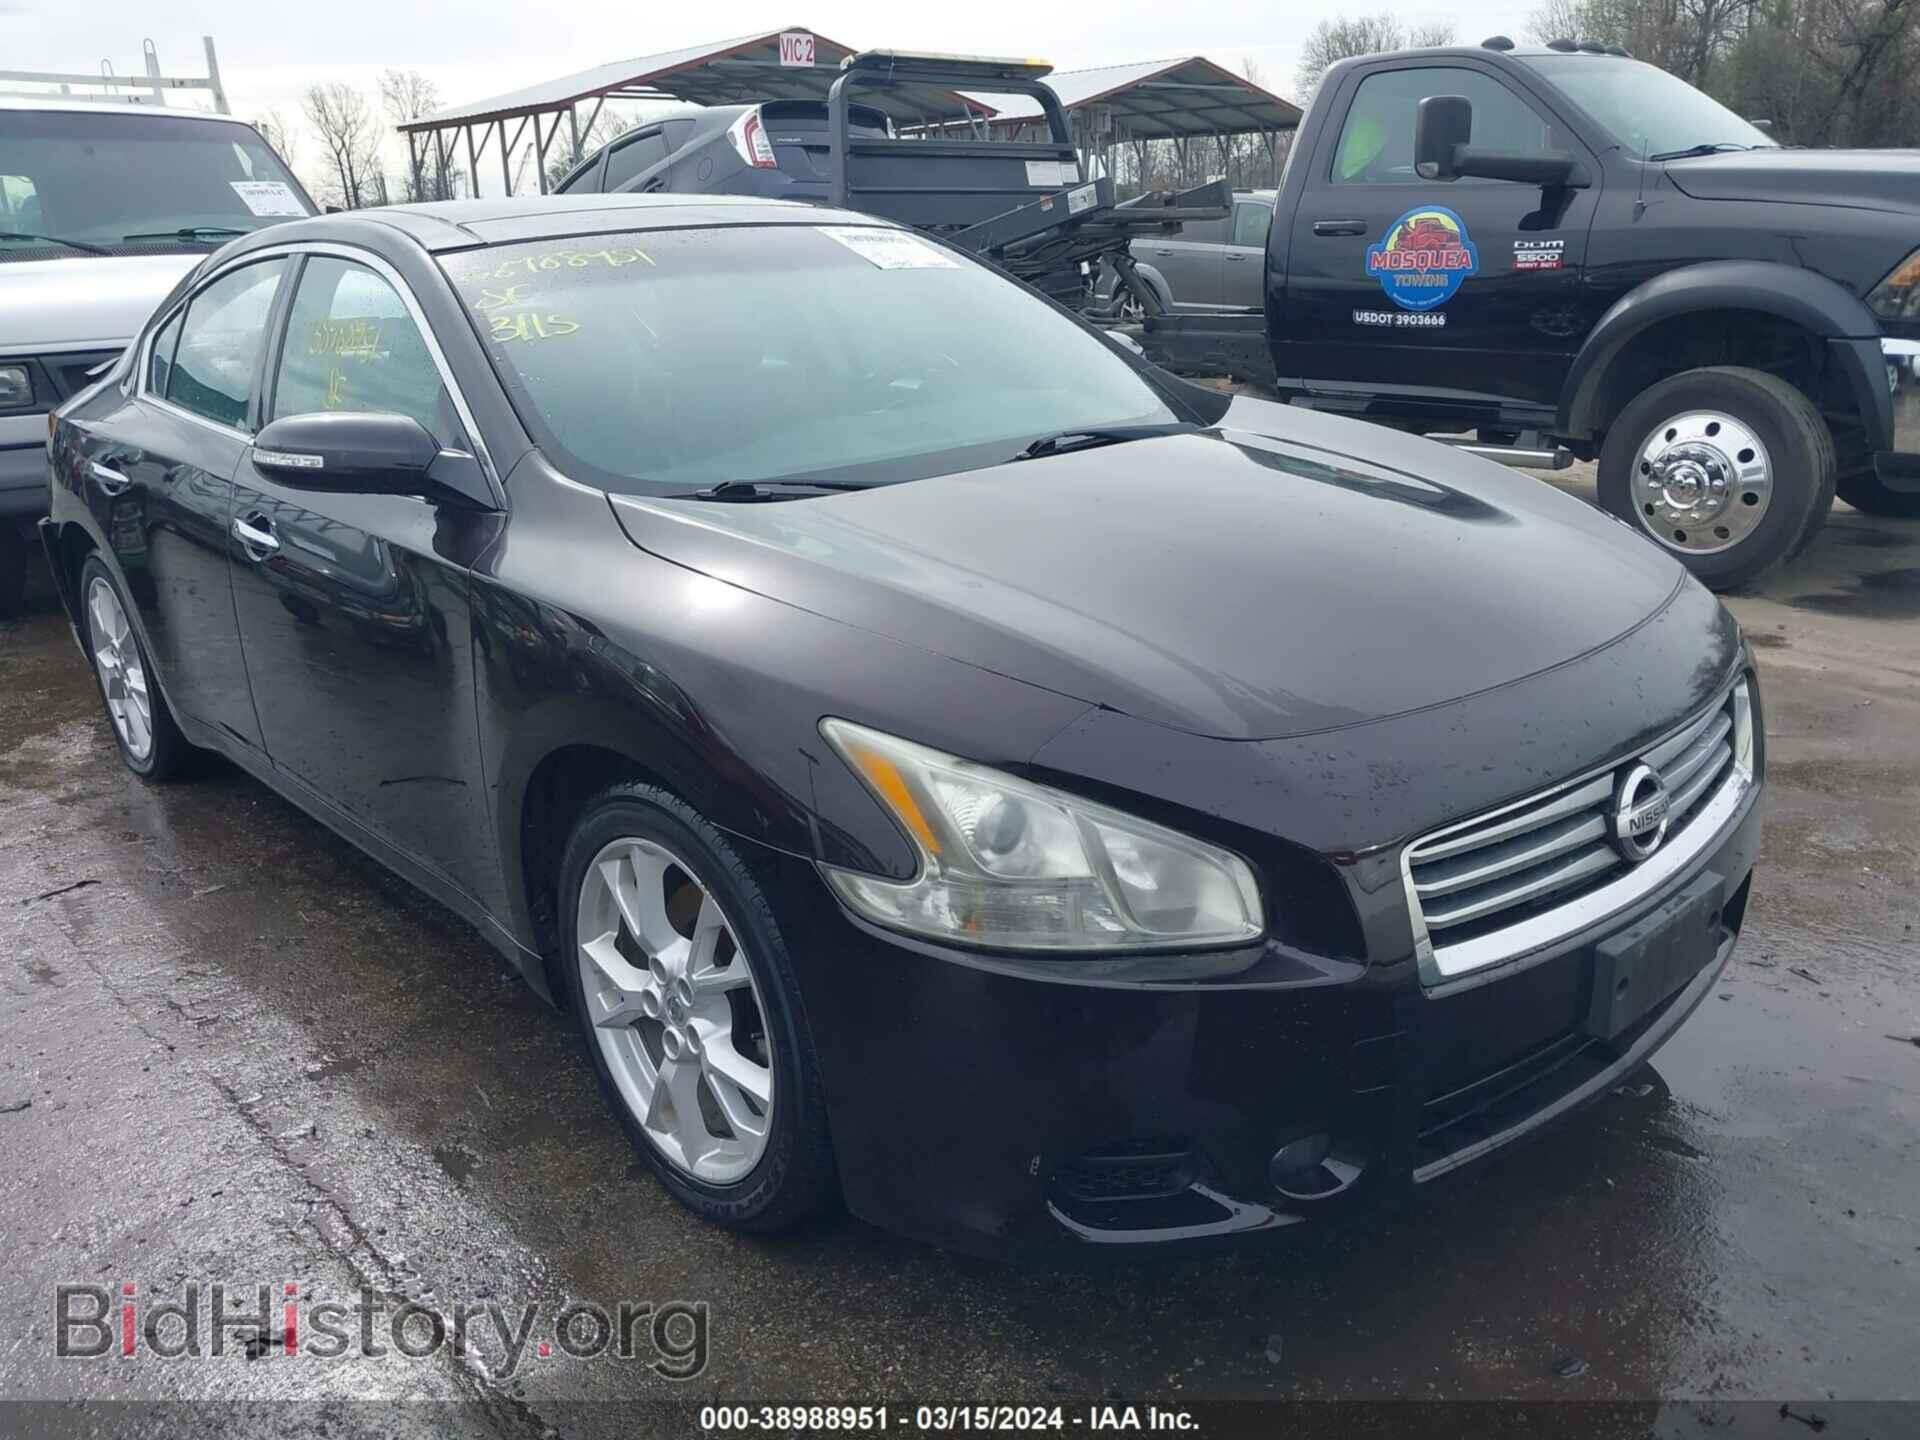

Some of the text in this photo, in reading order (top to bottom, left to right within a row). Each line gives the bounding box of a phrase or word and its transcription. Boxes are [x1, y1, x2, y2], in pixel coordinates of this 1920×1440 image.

[780, 38, 813, 62] VIC 2
[1370, 249, 1473, 273] MOSQUEA
[1517, 253, 1559, 262] 5500
[1392, 273, 1449, 288] TOWING
[1355, 312, 1446, 326] USDOT 3903666
